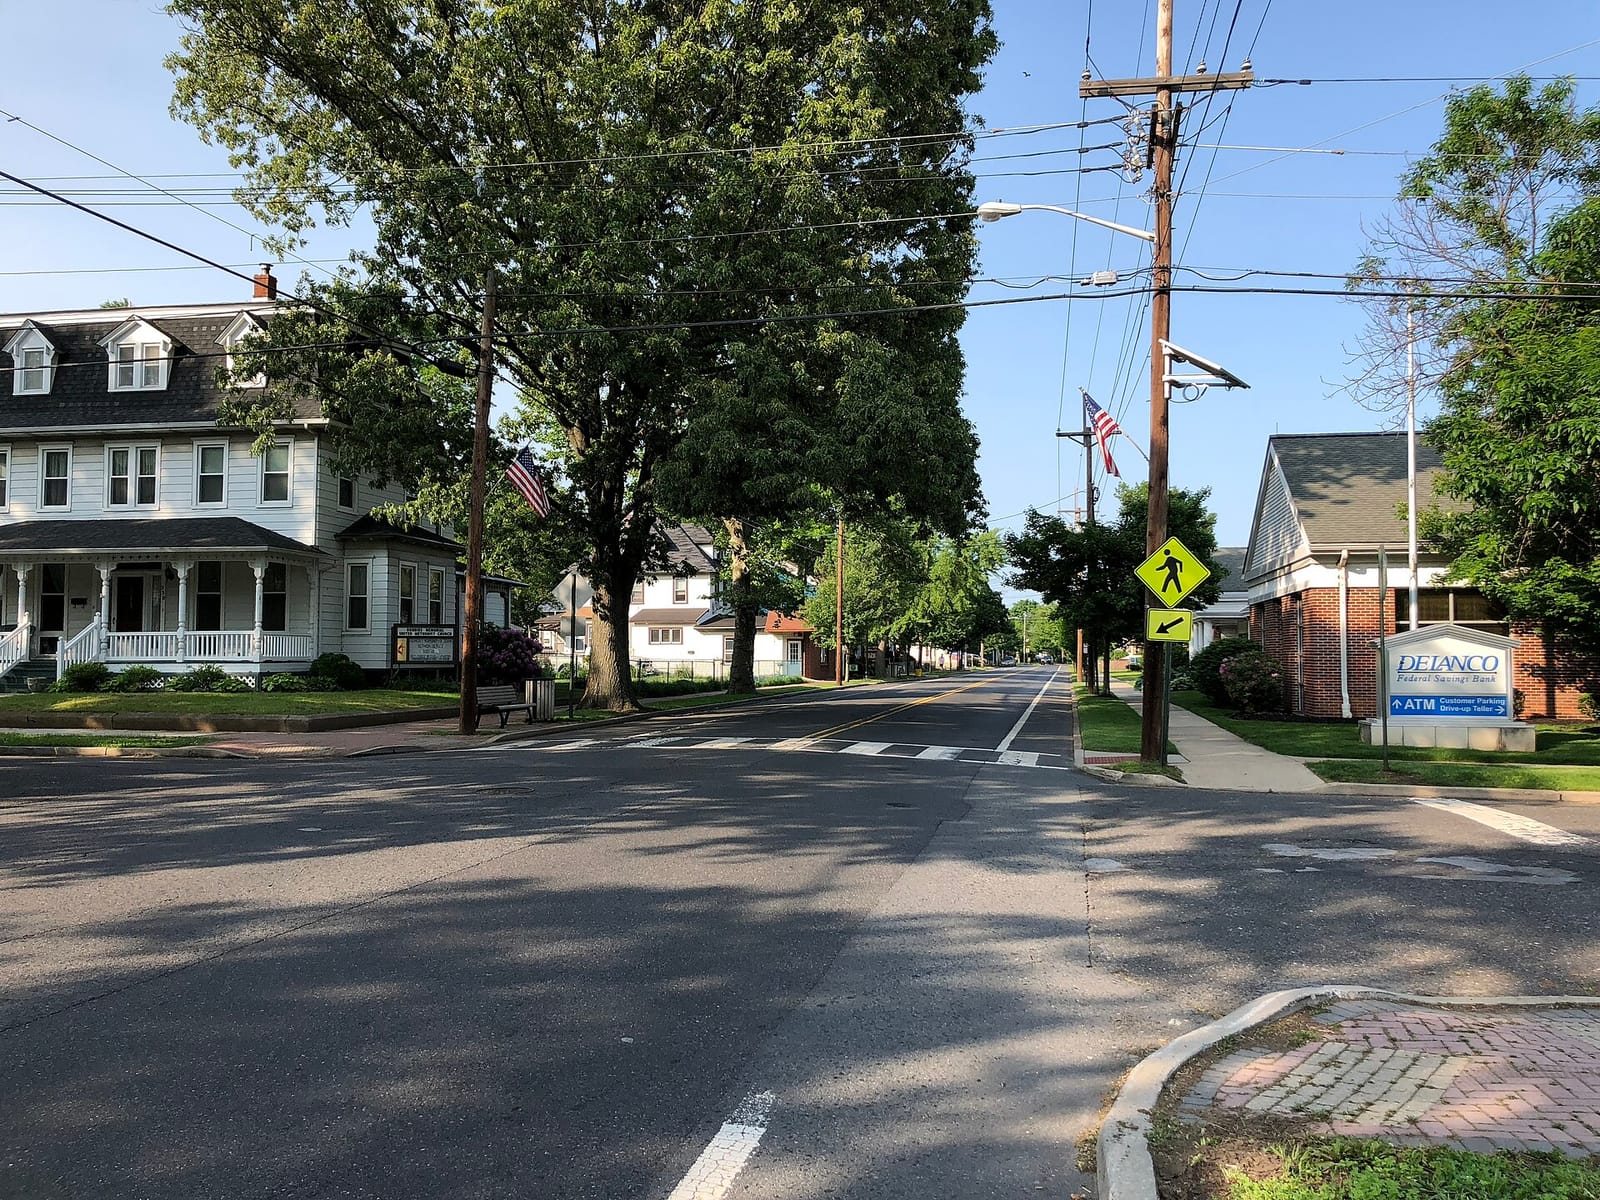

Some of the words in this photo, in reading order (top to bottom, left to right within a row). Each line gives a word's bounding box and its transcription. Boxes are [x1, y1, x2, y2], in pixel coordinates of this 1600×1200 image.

[1397, 655, 1499, 671] DELANCO
[1397, 674, 1430, 682] Federal
[1434, 674, 1469, 683] Savings
[1472, 674, 1496, 682] Bank
[1404, 699, 1435, 710] ATM
